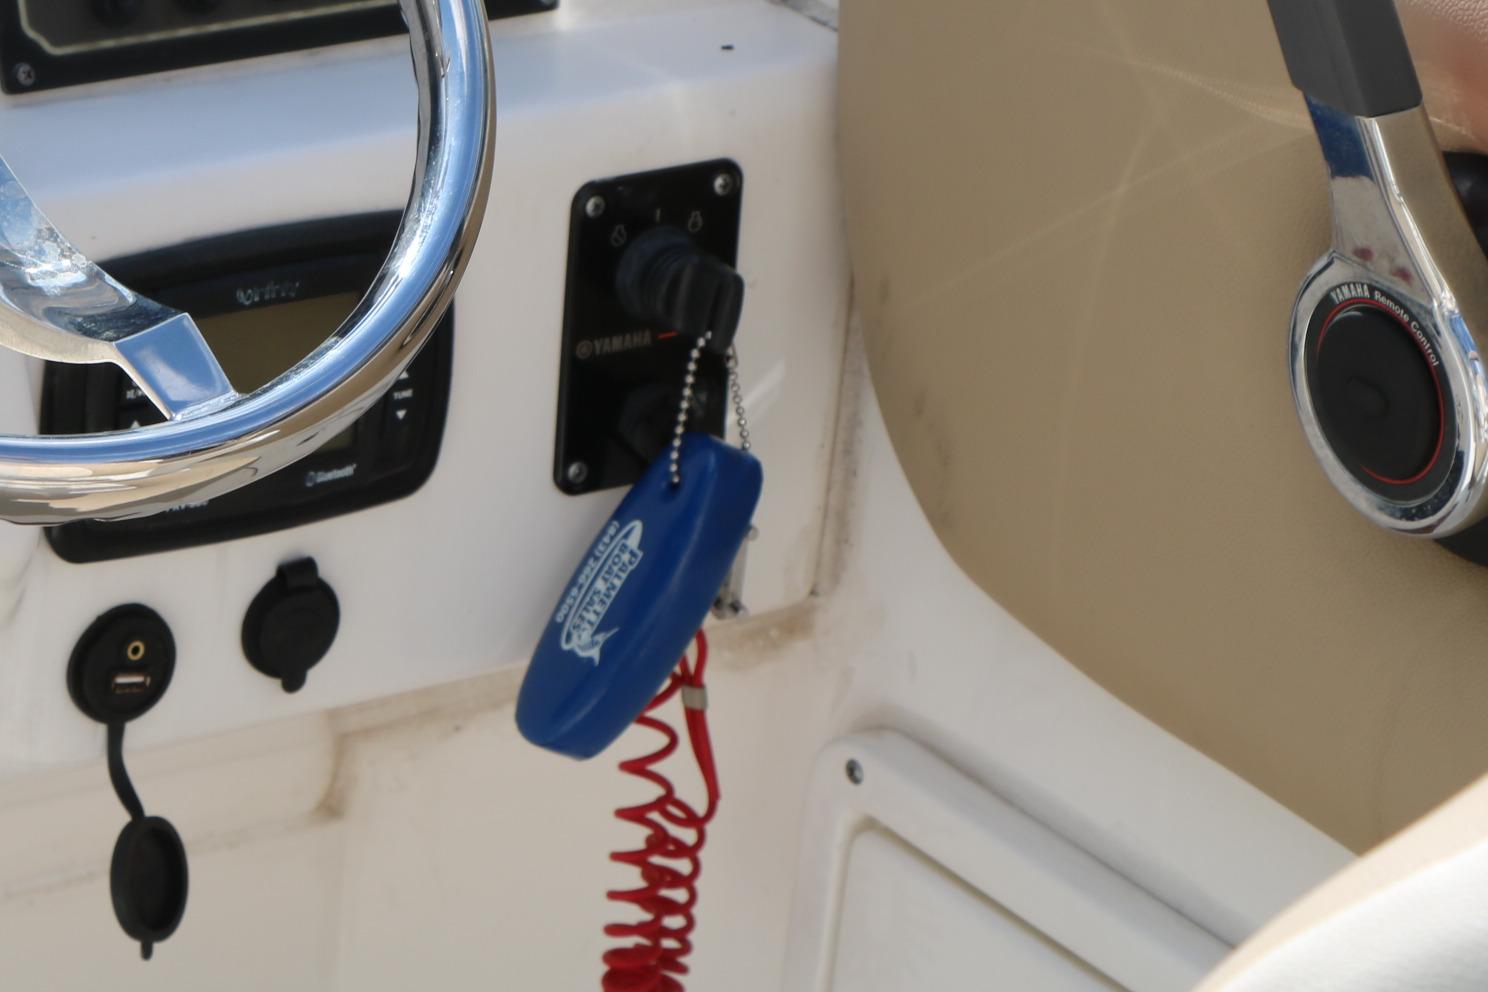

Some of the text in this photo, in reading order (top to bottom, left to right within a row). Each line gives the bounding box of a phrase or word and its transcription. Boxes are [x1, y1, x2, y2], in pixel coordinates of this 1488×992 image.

[594, 329, 651, 356] YAMAHA
[1330, 283, 1439, 366] YAMAHA Remote Control
[572, 542, 628, 631] BOAT SALES
